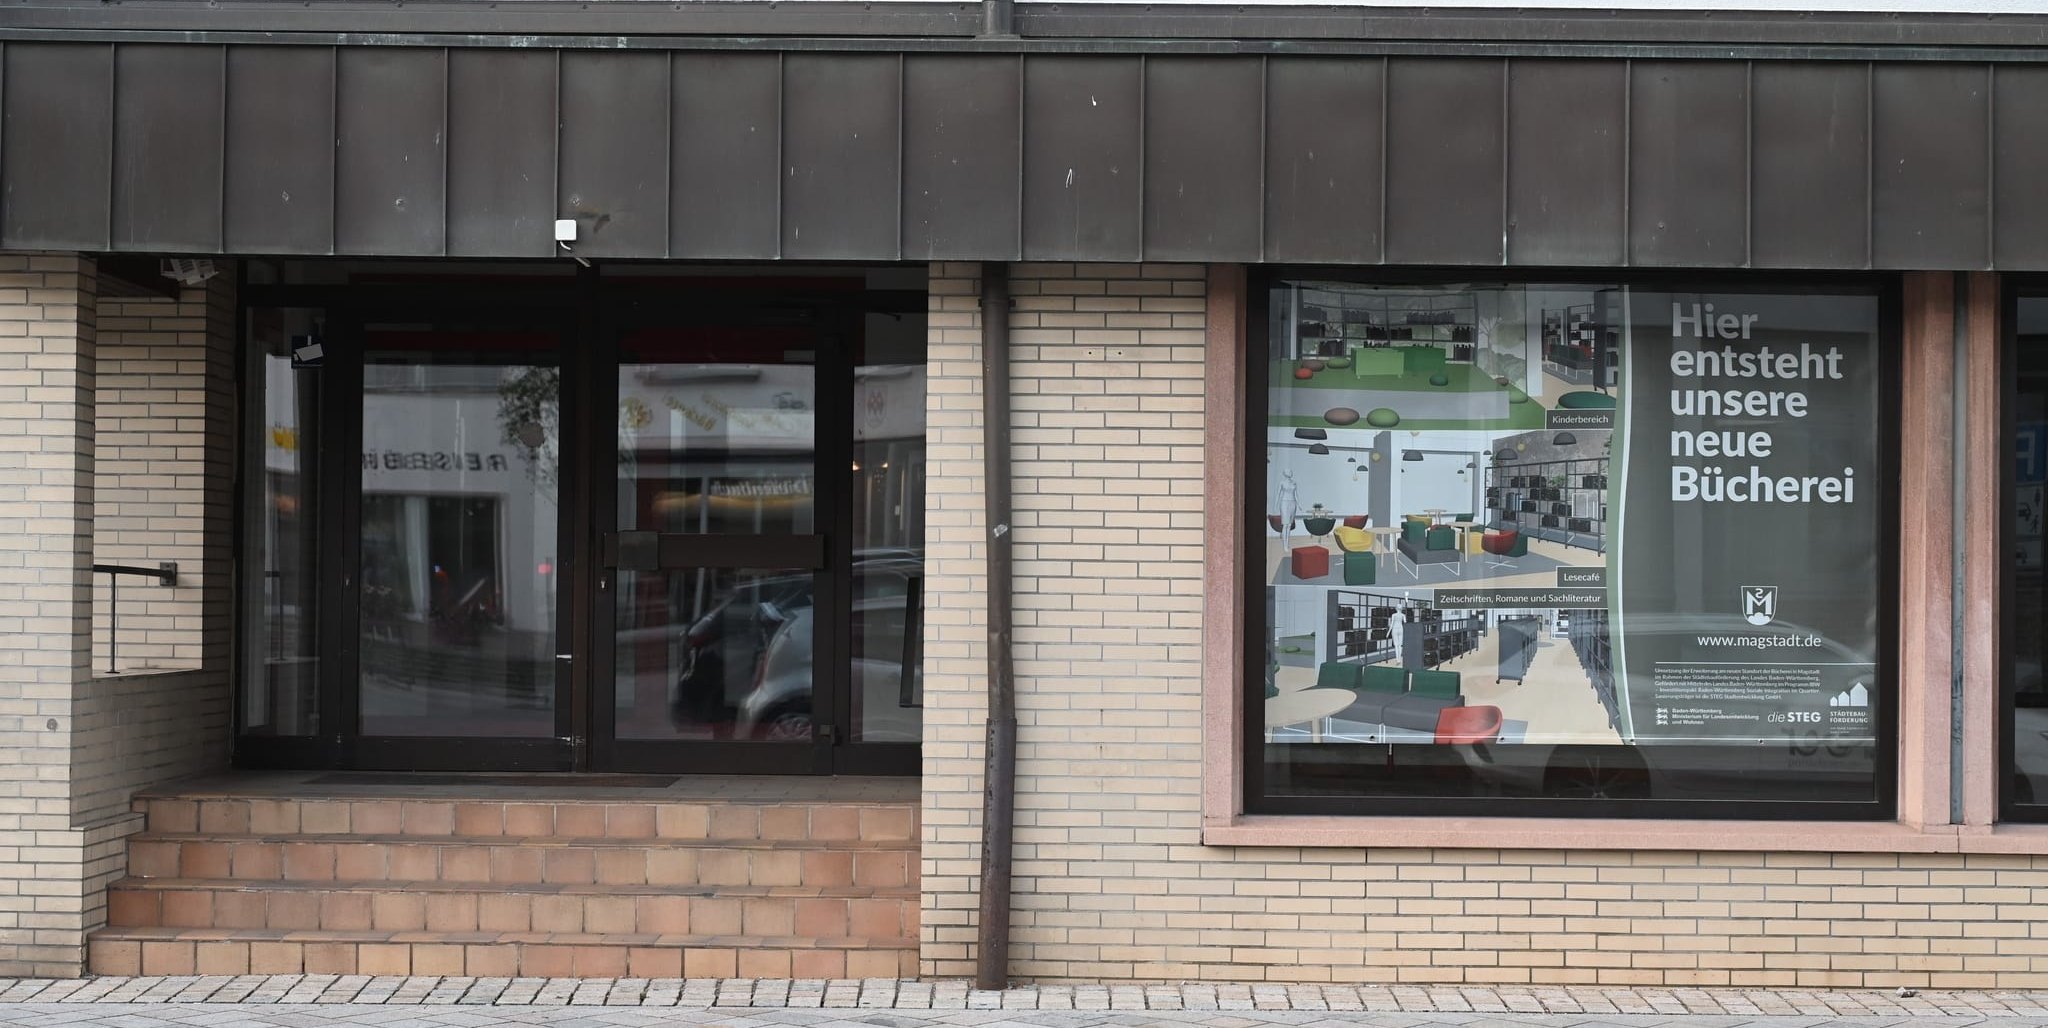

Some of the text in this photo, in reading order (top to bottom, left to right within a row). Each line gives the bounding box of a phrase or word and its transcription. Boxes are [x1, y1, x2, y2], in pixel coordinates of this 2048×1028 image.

[1672, 302, 1758, 339] Hier
[1670, 342, 1843, 379] entsteht
[1670, 389, 1808, 417] unsere
[1552, 415, 1609, 424] Kinderbereich
[1671, 429, 1772, 457] neue
[1671, 465, 1854, 503] Bücherei
[1563, 573, 1600, 582] Lesecafé
[1440, 595, 1494, 604] Zeitschriften,
[1530, 594, 1547, 602] und
[1548, 594, 1601, 602] Sachliteratur
[1697, 634, 1822, 649] www.magstadt.de
[1767, 712, 1822, 722] die STEG
